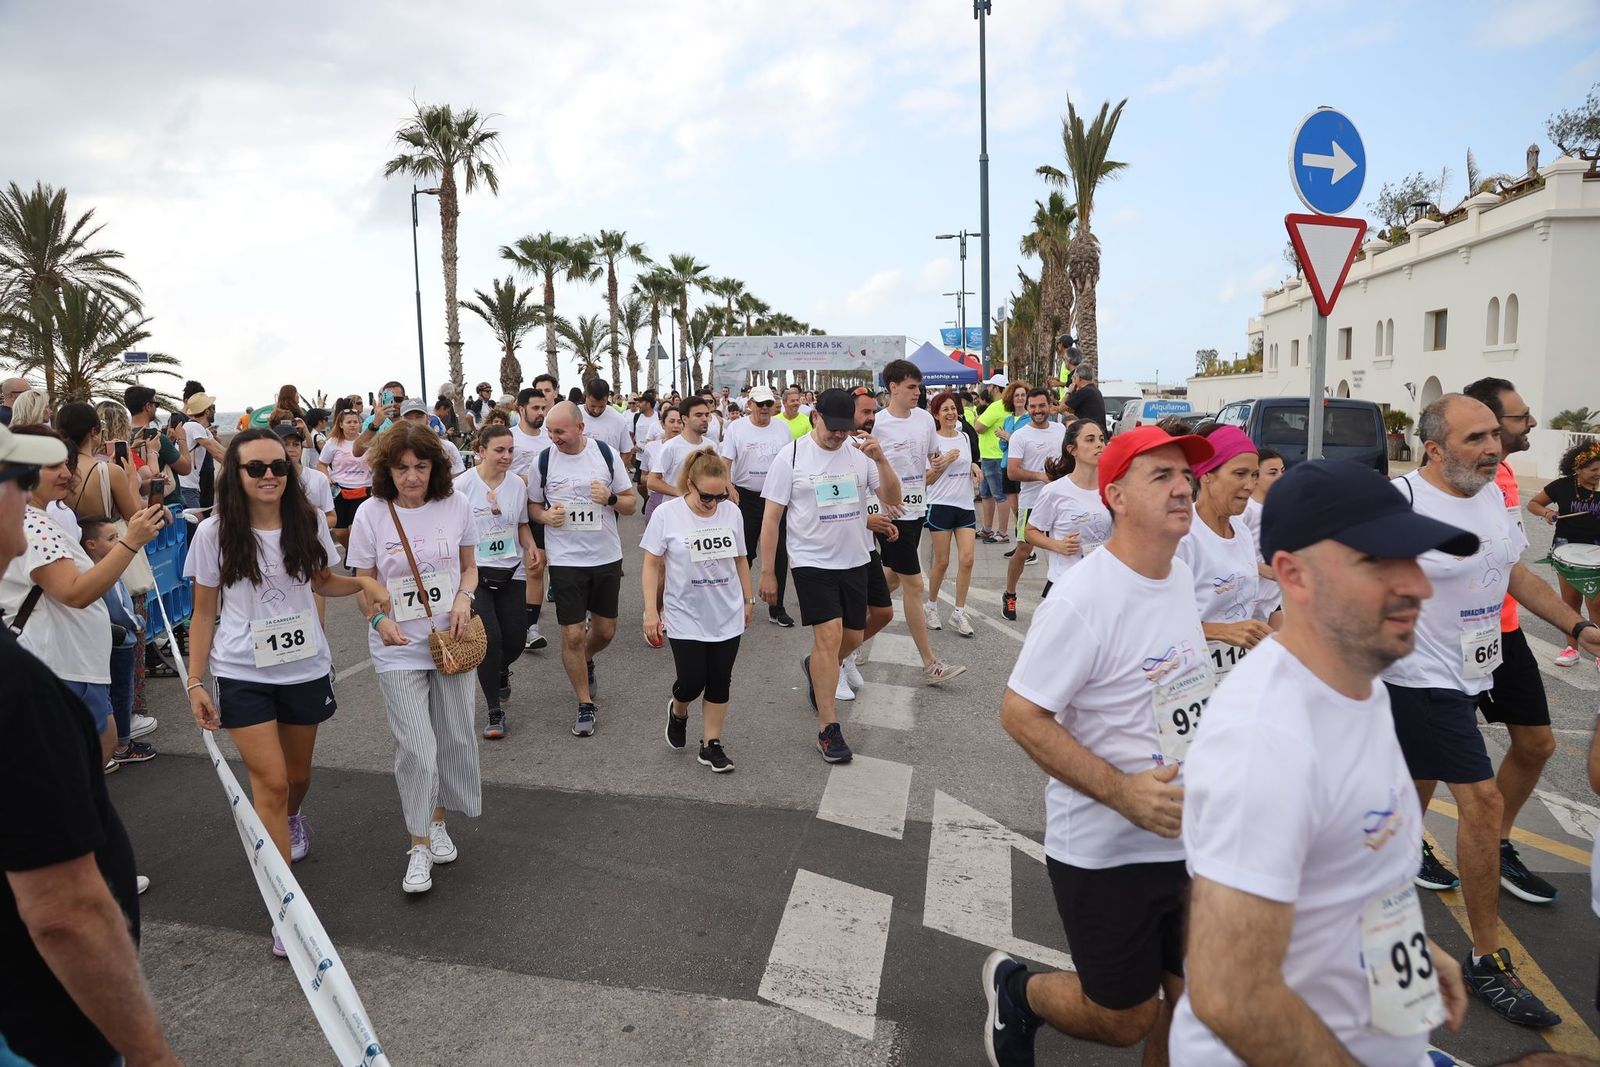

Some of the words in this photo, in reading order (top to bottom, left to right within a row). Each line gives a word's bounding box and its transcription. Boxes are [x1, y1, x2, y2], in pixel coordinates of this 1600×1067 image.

[773, 341, 785, 349] 3A
[786, 341, 829, 349] CARRERA
[831, 341, 842, 349] 5K
[832, 484, 840, 496] 3
[903, 494, 923, 504] 430
[569, 511, 594, 522] 111
[489, 540, 505, 551] 40
[693, 536, 732, 551] 1056
[266, 629, 305, 651] 138
[1475, 639, 1499, 663] 665
